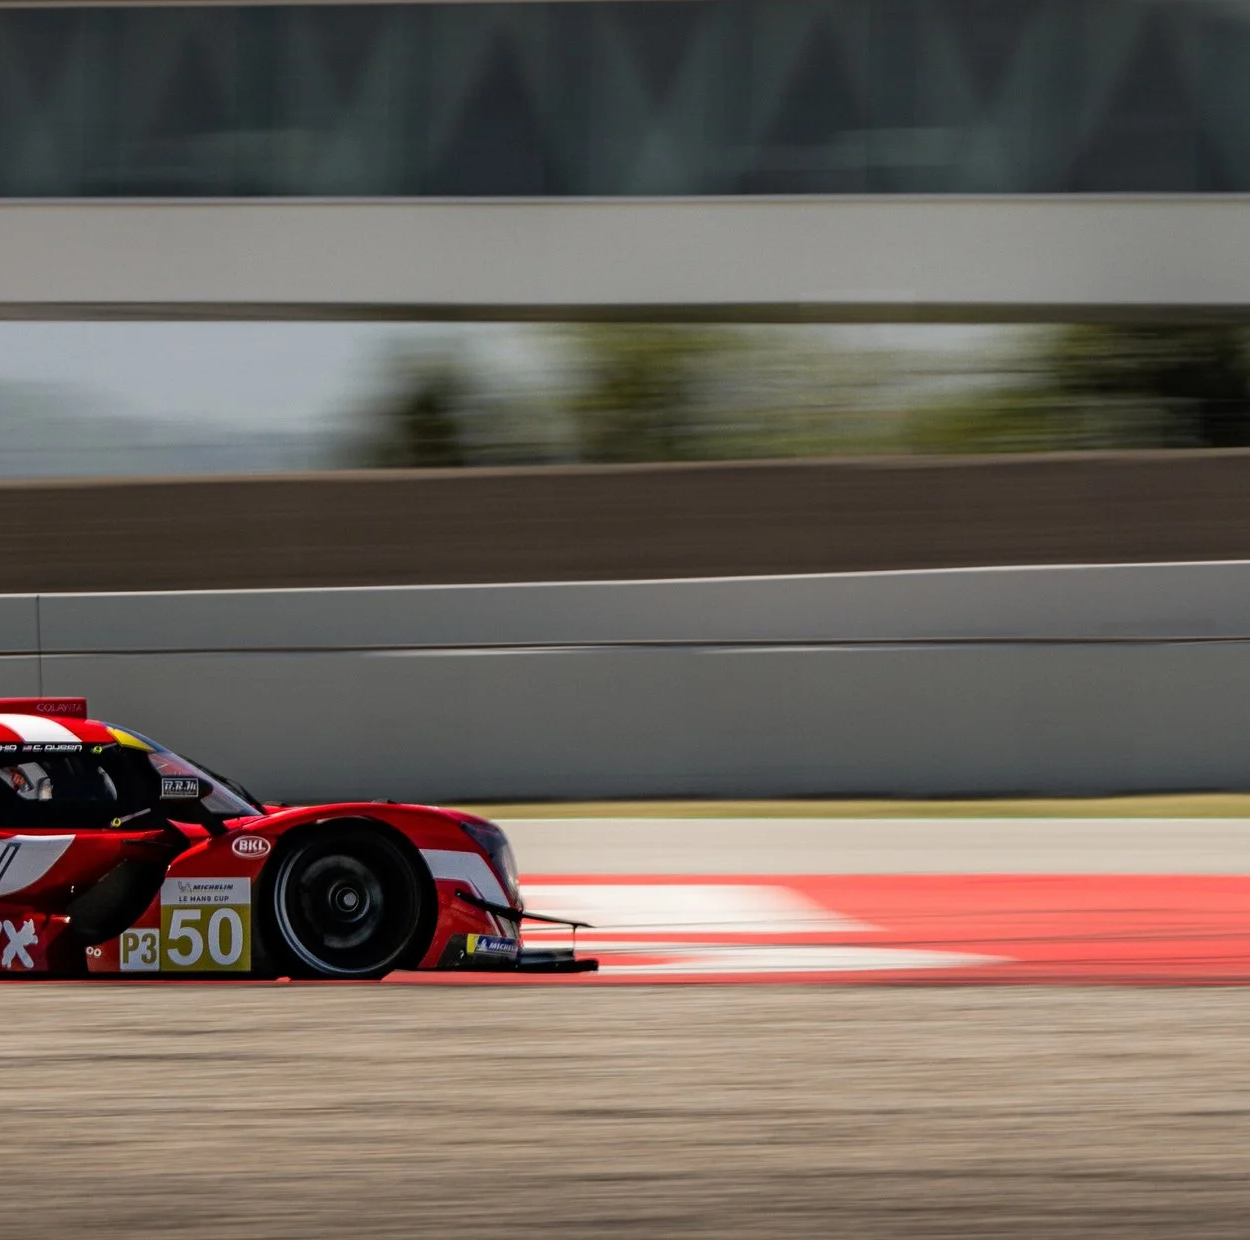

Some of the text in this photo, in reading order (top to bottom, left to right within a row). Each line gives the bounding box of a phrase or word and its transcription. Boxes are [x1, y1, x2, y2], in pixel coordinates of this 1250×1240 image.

[36, 703, 83, 712] COLAVITA
[239, 839, 266, 852] BKL
[122, 932, 157, 964] P3
[167, 908, 243, 966] 50
